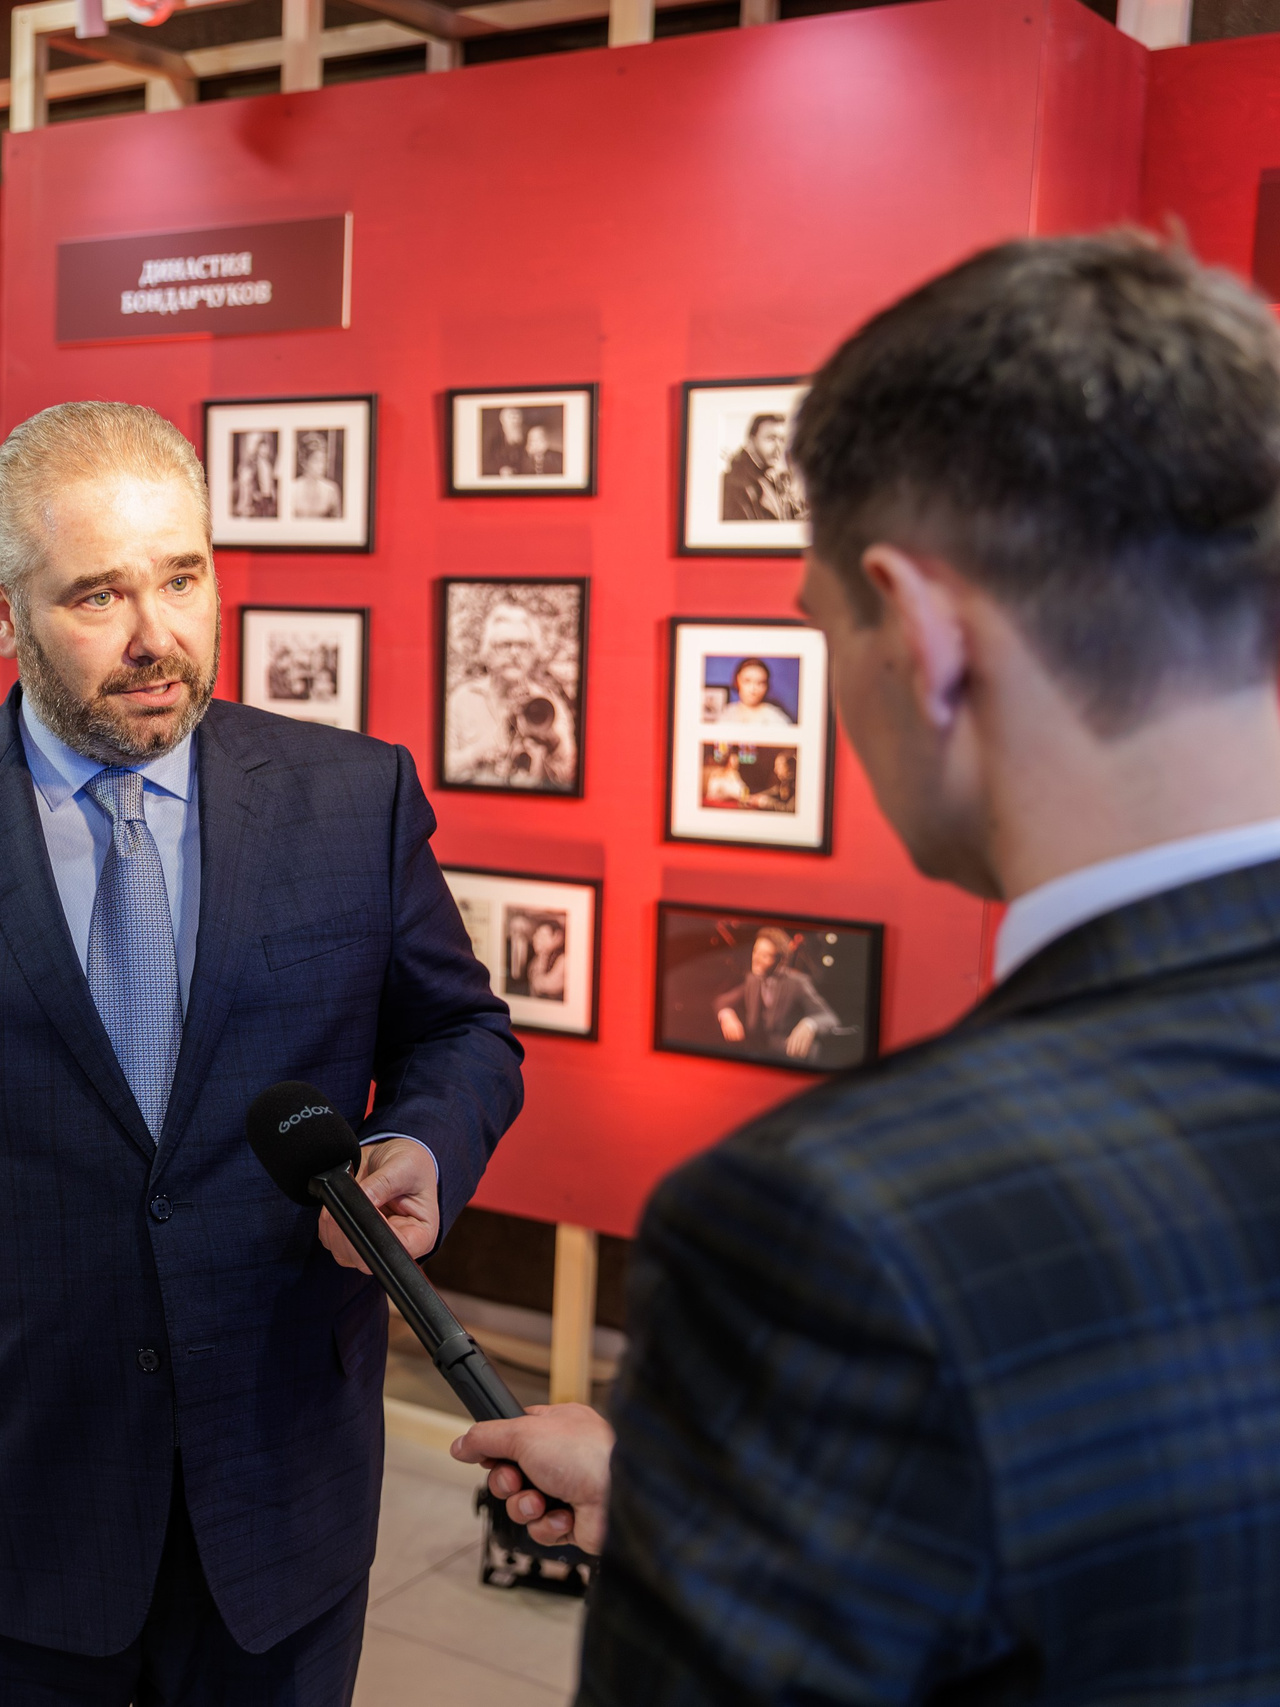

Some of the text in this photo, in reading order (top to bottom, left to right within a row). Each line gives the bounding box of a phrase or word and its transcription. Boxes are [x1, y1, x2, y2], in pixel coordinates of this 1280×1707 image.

[139, 252, 252, 286] ДИНАСТИЯ
[120, 280, 273, 315] БОНДАРЧУКОВ
[279, 1105, 333, 1133] Godox
